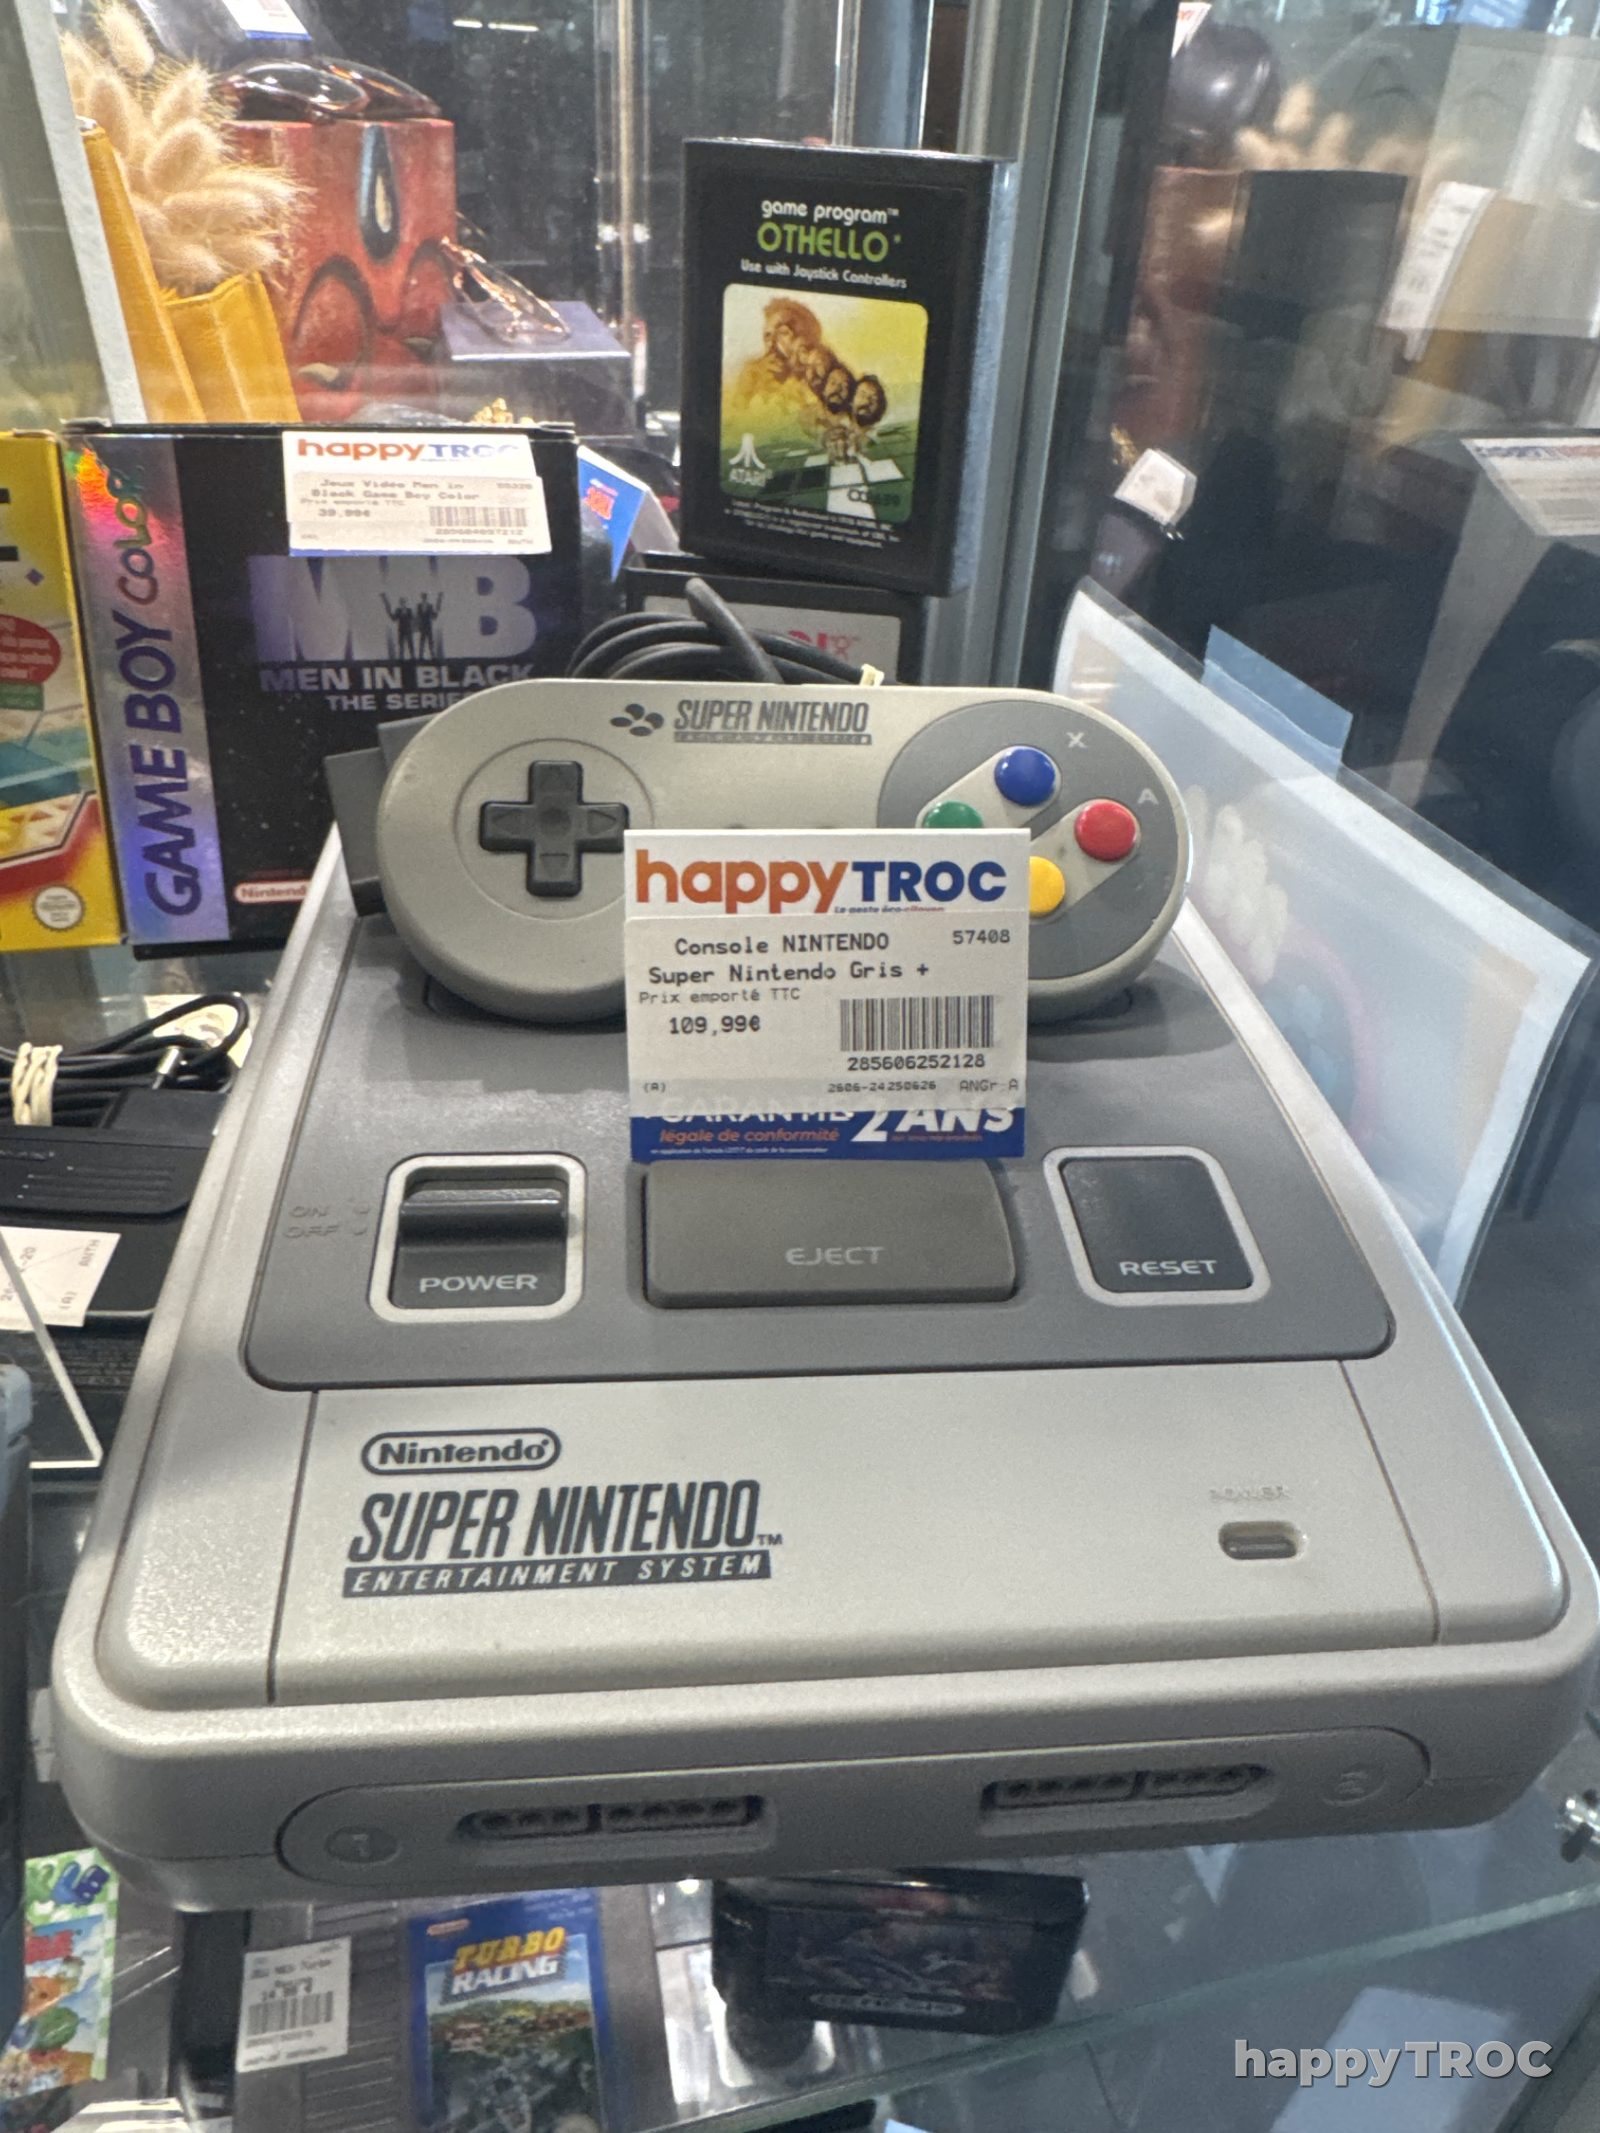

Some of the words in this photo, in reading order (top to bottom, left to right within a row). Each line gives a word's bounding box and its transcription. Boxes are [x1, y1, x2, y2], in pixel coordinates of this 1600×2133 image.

[761, 200, 808, 219] game
[740, 258, 762, 273] Use
[765, 261, 791, 276] with
[793, 263, 839, 281] Joystick
[842, 269, 908, 289] Controllers
[113, 610, 183, 734] BOY
[258, 665, 351, 692] MEN
[361, 664, 403, 691] IN
[414, 662, 535, 689] BLACK
[325, 693, 377, 711] THE
[386, 691, 473, 710] SERIE
[674, 699, 754, 732] SUPER
[757, 700, 870, 733] NINTENDO
[1066, 731, 1088, 749] X
[1137, 787, 1160, 805] A
[129, 743, 201, 916] GAME
[241, 884, 308, 899] Nintend
[636, 848, 1007, 914] happyTROC
[675, 937, 769, 956] Console
[782, 932, 890, 954] NINTENDO
[951, 928, 1011, 946] 57408
[649, 966, 715, 985] Super
[729, 963, 836, 983] Nintendo
[849, 960, 903, 979] Gris
[916, 962, 930, 977] +
[639, 991, 680, 1005] Prix
[690, 989, 760, 1004] emporté
[770, 987, 801, 1000] TTC
[669, 1015, 761, 1037] 109,99€
[847, 1053, 986, 1072] 285606252128
[659, 1129, 714, 1146] légale
[717, 1128, 740, 1142] de
[743, 1127, 841, 1142] conformité
[785, 1245, 886, 1267] EJECT
[1118, 1259, 1218, 1276] RESET
[419, 1273, 539, 1294] POWER
[348, 1488, 520, 1563] SUPER
[351, 1560, 619, 1594] ENTERTAINMENT
[637, 1553, 763, 1581] SYSTEM
[453, 1925, 567, 1975] TURBO
[450, 1955, 560, 1996] RACING
